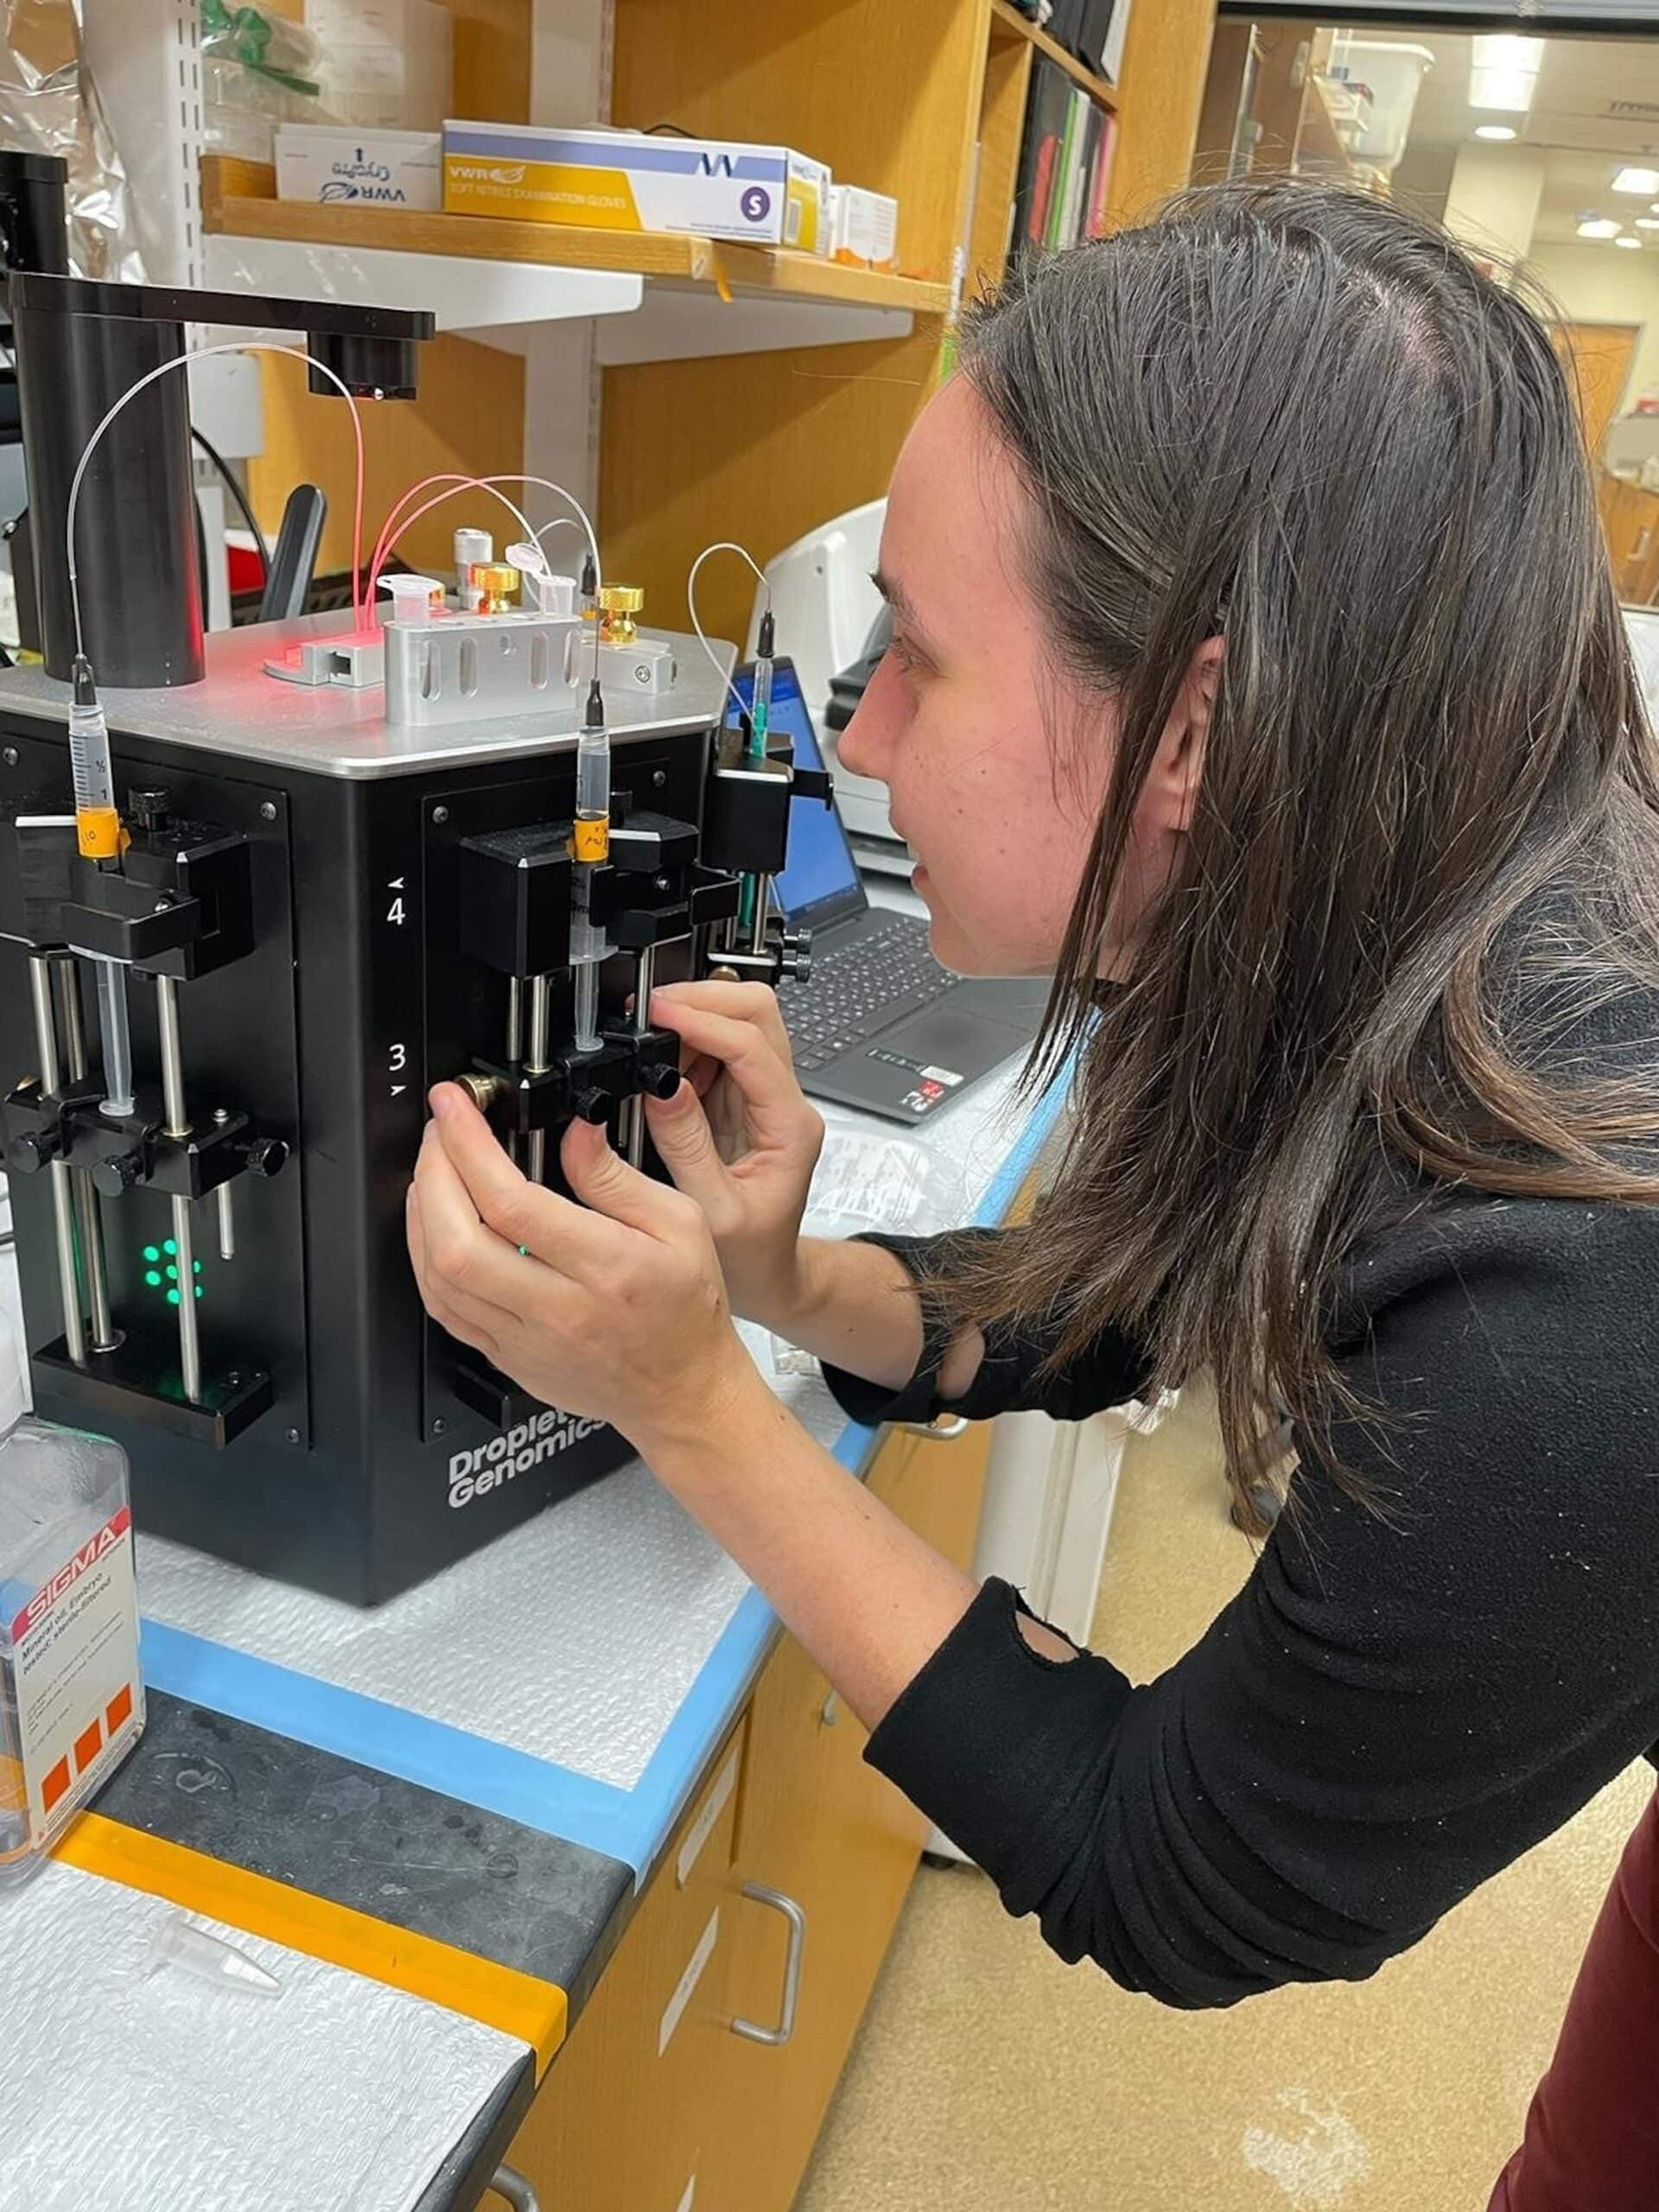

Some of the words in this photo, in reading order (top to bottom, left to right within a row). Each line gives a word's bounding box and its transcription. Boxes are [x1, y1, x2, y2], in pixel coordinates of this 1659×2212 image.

[449, 166, 488, 181] VWR
[360, 187, 406, 202] VWR
[450, 182, 474, 194] SOFT
[748, 195, 762, 216] S
[387, 897, 406, 925] 4
[389, 1043, 406, 1071] 3
[449, 1409, 568, 1485] Droplet
[27, 1527, 116, 1626] SIGMA
